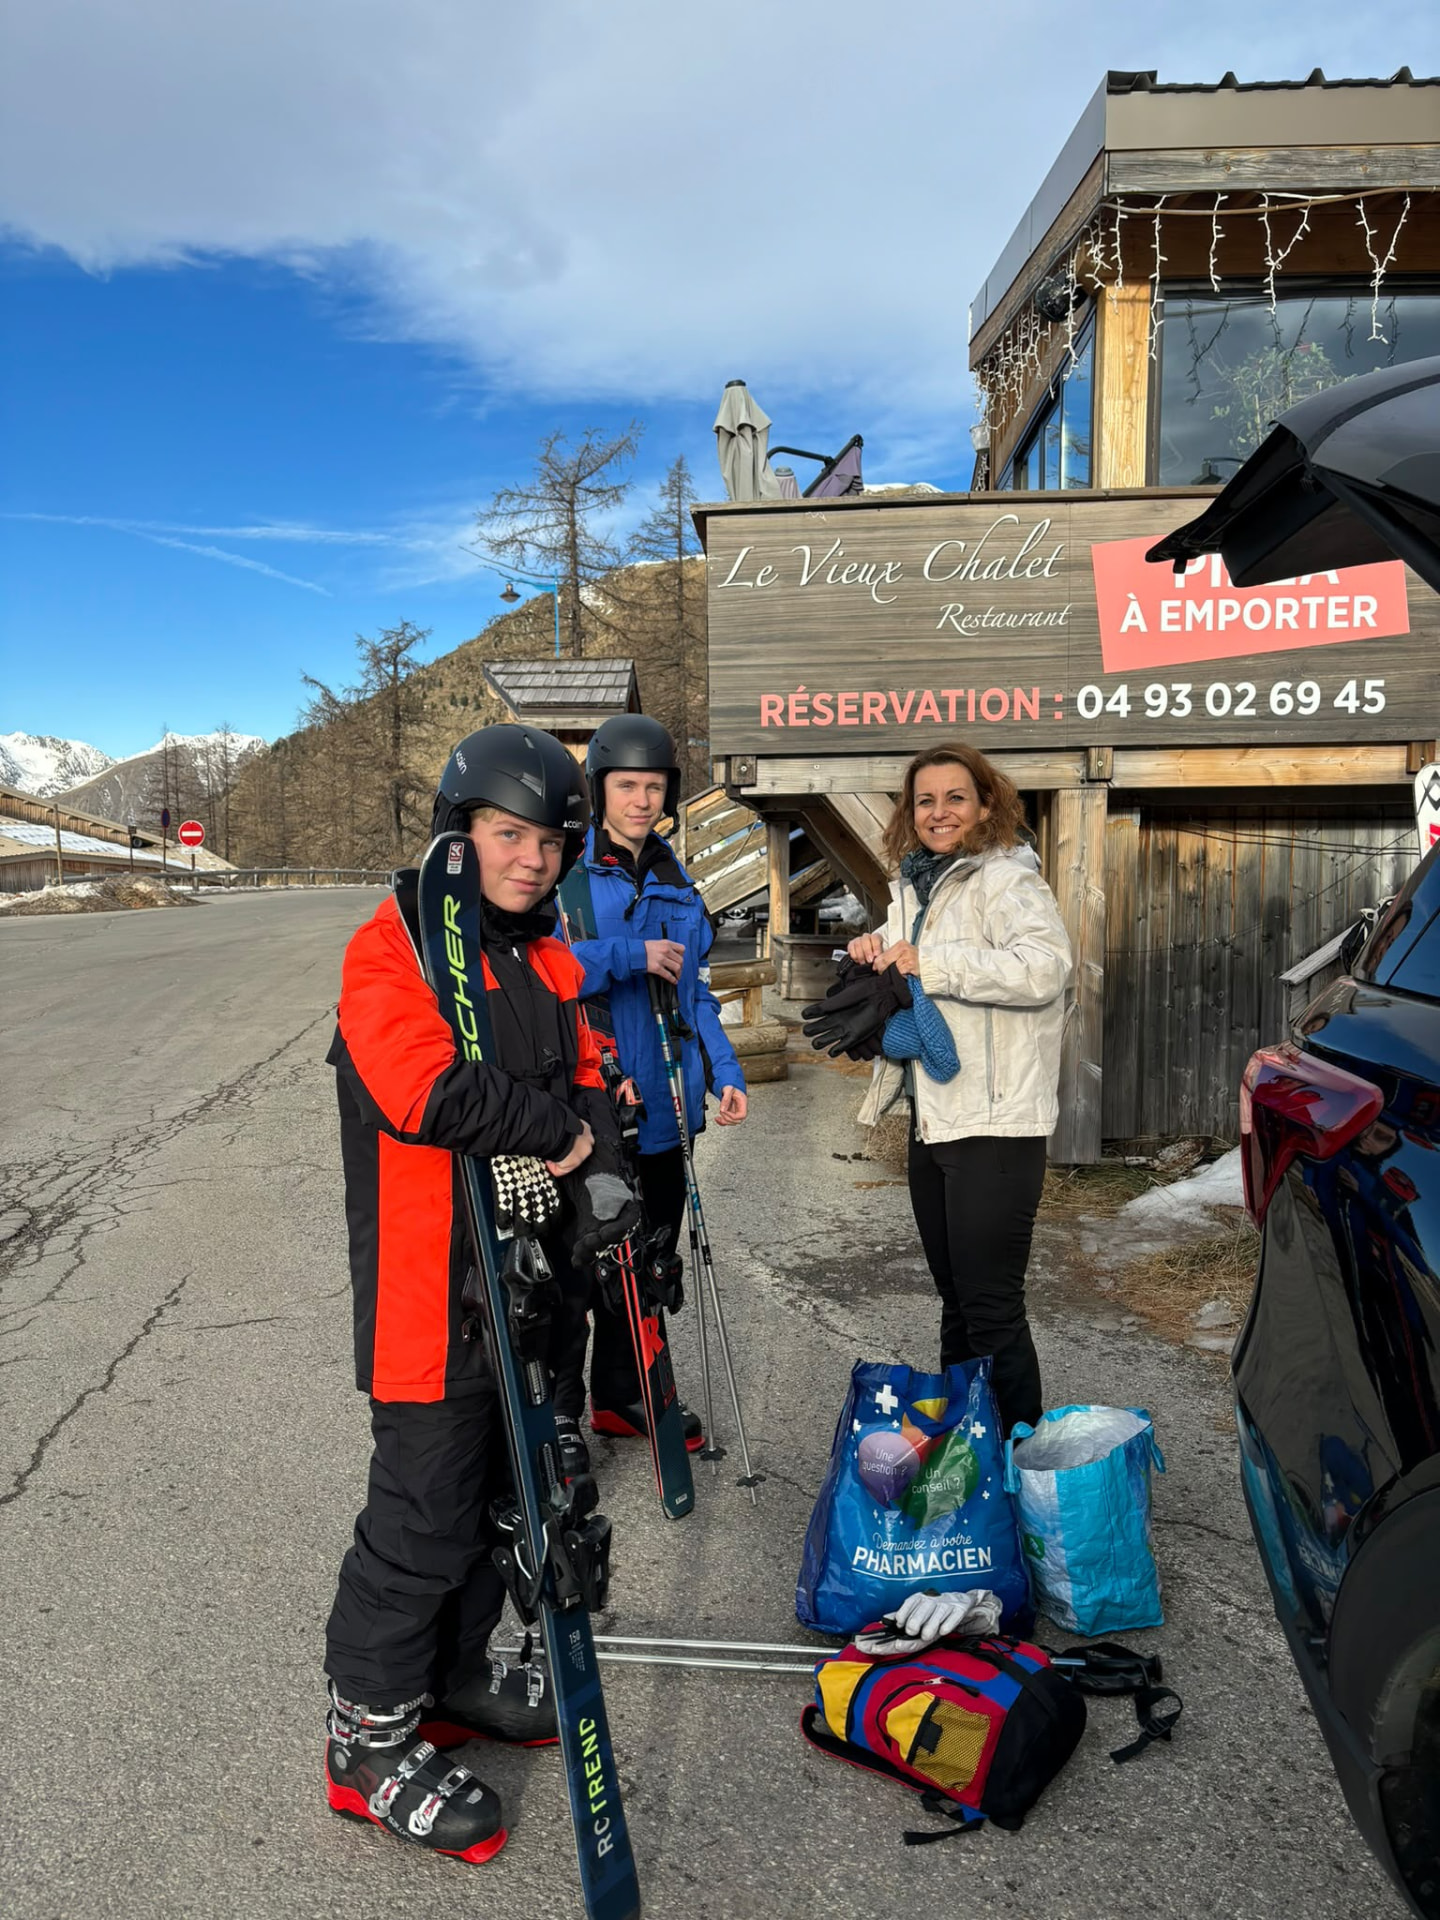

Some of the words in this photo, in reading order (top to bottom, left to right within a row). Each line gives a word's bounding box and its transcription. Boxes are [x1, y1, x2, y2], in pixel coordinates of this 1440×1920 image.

[718, 546, 779, 588] Le
[791, 537, 904, 604] Vieux
[923, 513, 1066, 583] Chalet
[936, 602, 1072, 636] Restaurant
[1119, 593, 1149, 633] À
[1160, 595, 1378, 632] EMPORTER
[760, 685, 1041, 727] RÉSERVATION
[1076, 684, 1132, 719] 04
[1144, 683, 1193, 718] 93
[1205, 682, 1257, 717] 02
[1269, 680, 1321, 715] 69
[1333, 679, 1386, 714] 45
[875, 1448, 894, 1462] Une
[862, 1461, 897, 1476] question
[925, 1468, 940, 1480] Un
[912, 1479, 951, 1494] conseil
[872, 1532, 927, 1551] Demandez
[930, 1533, 940, 1548] à
[941, 1532, 973, 1547] votre
[852, 1546, 992, 1575] PHARMACIEN
